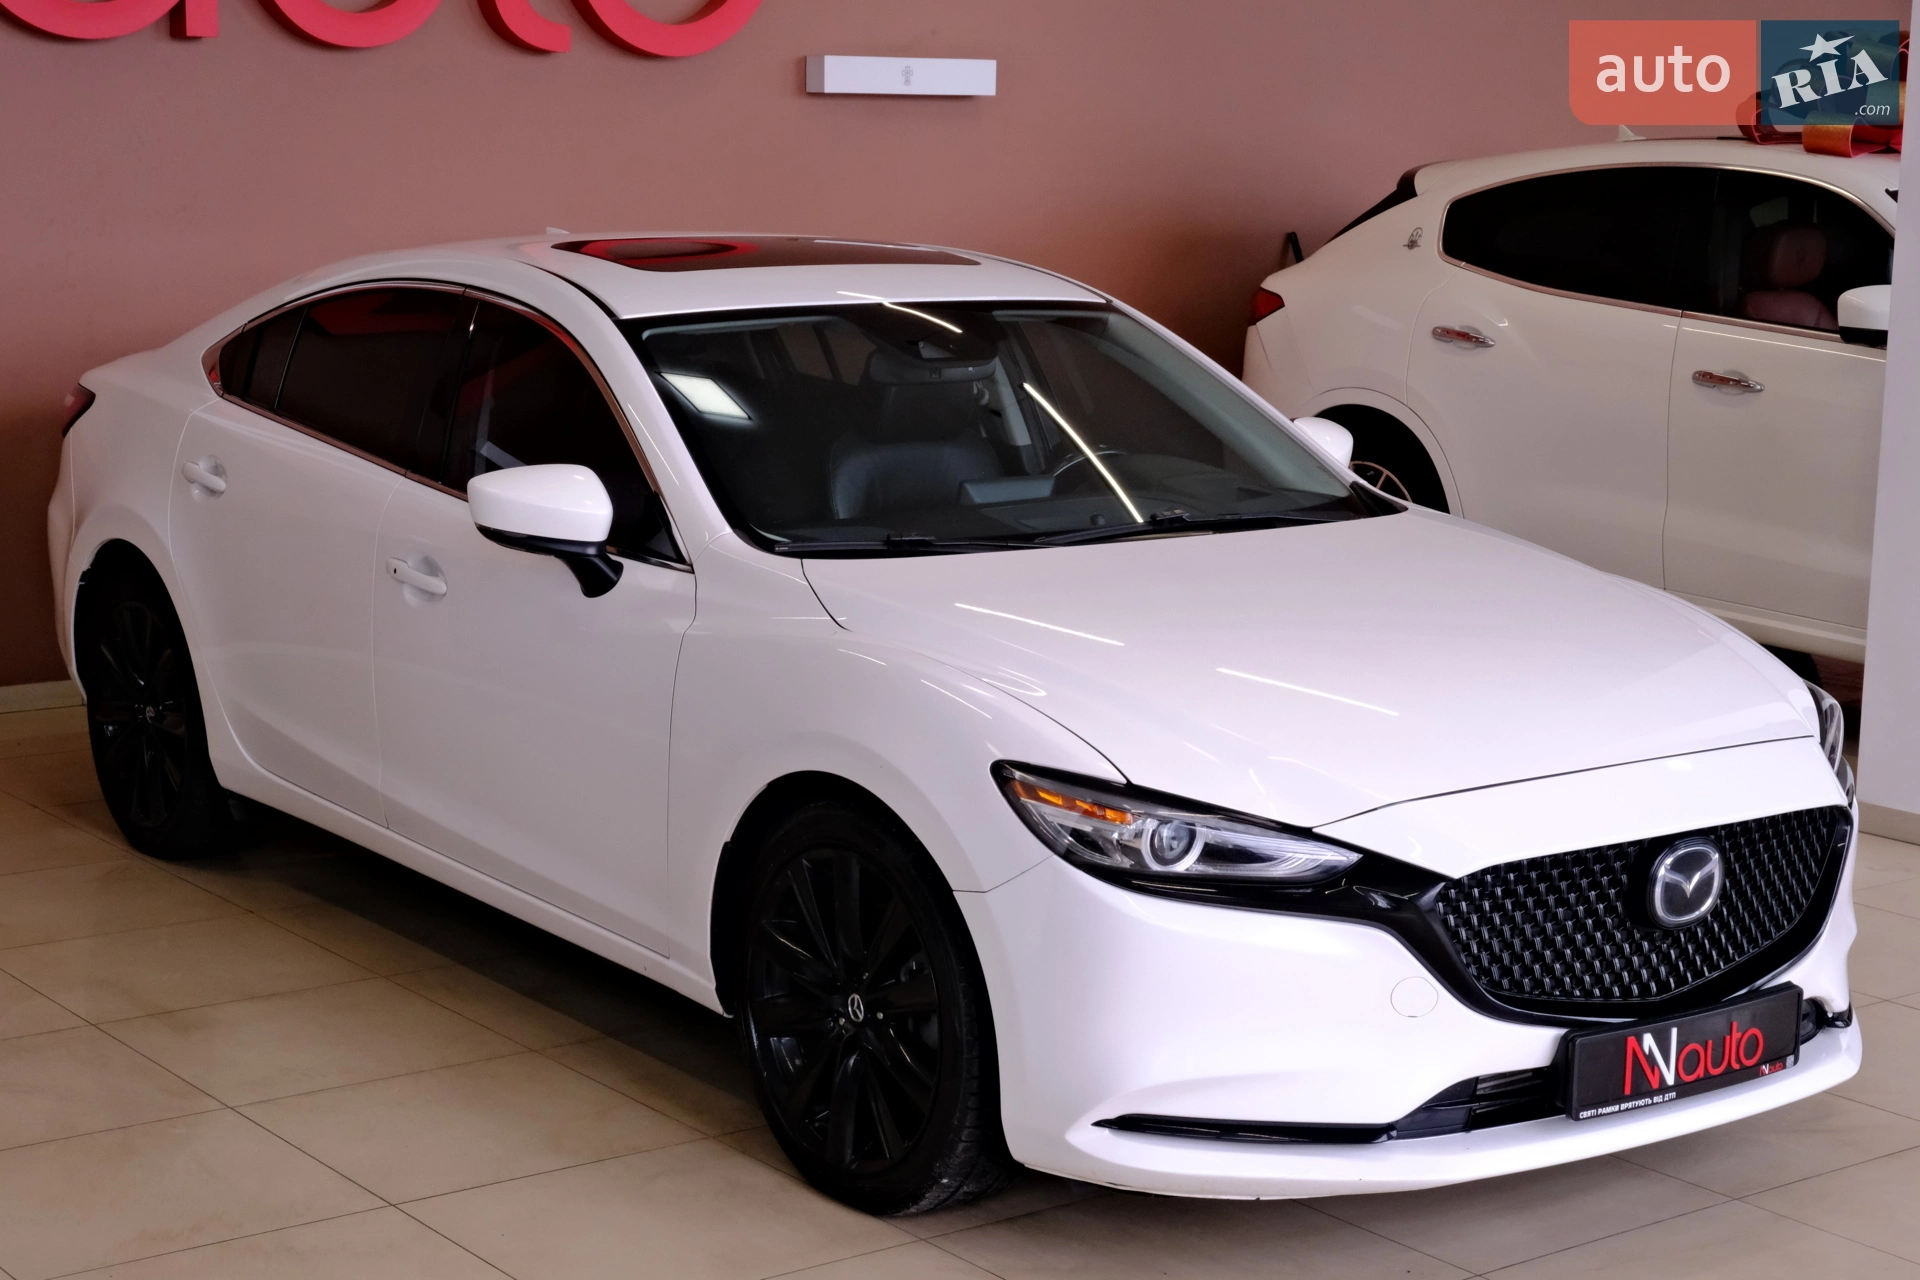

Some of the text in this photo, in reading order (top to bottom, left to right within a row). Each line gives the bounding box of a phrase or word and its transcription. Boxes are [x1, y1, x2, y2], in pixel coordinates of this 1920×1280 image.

[1598, 1104, 1620, 1115] РАМКИ
[1620, 1098, 1652, 1111] ВРЯТУЮТЬ
[1653, 1095, 1663, 1104] ВІД
